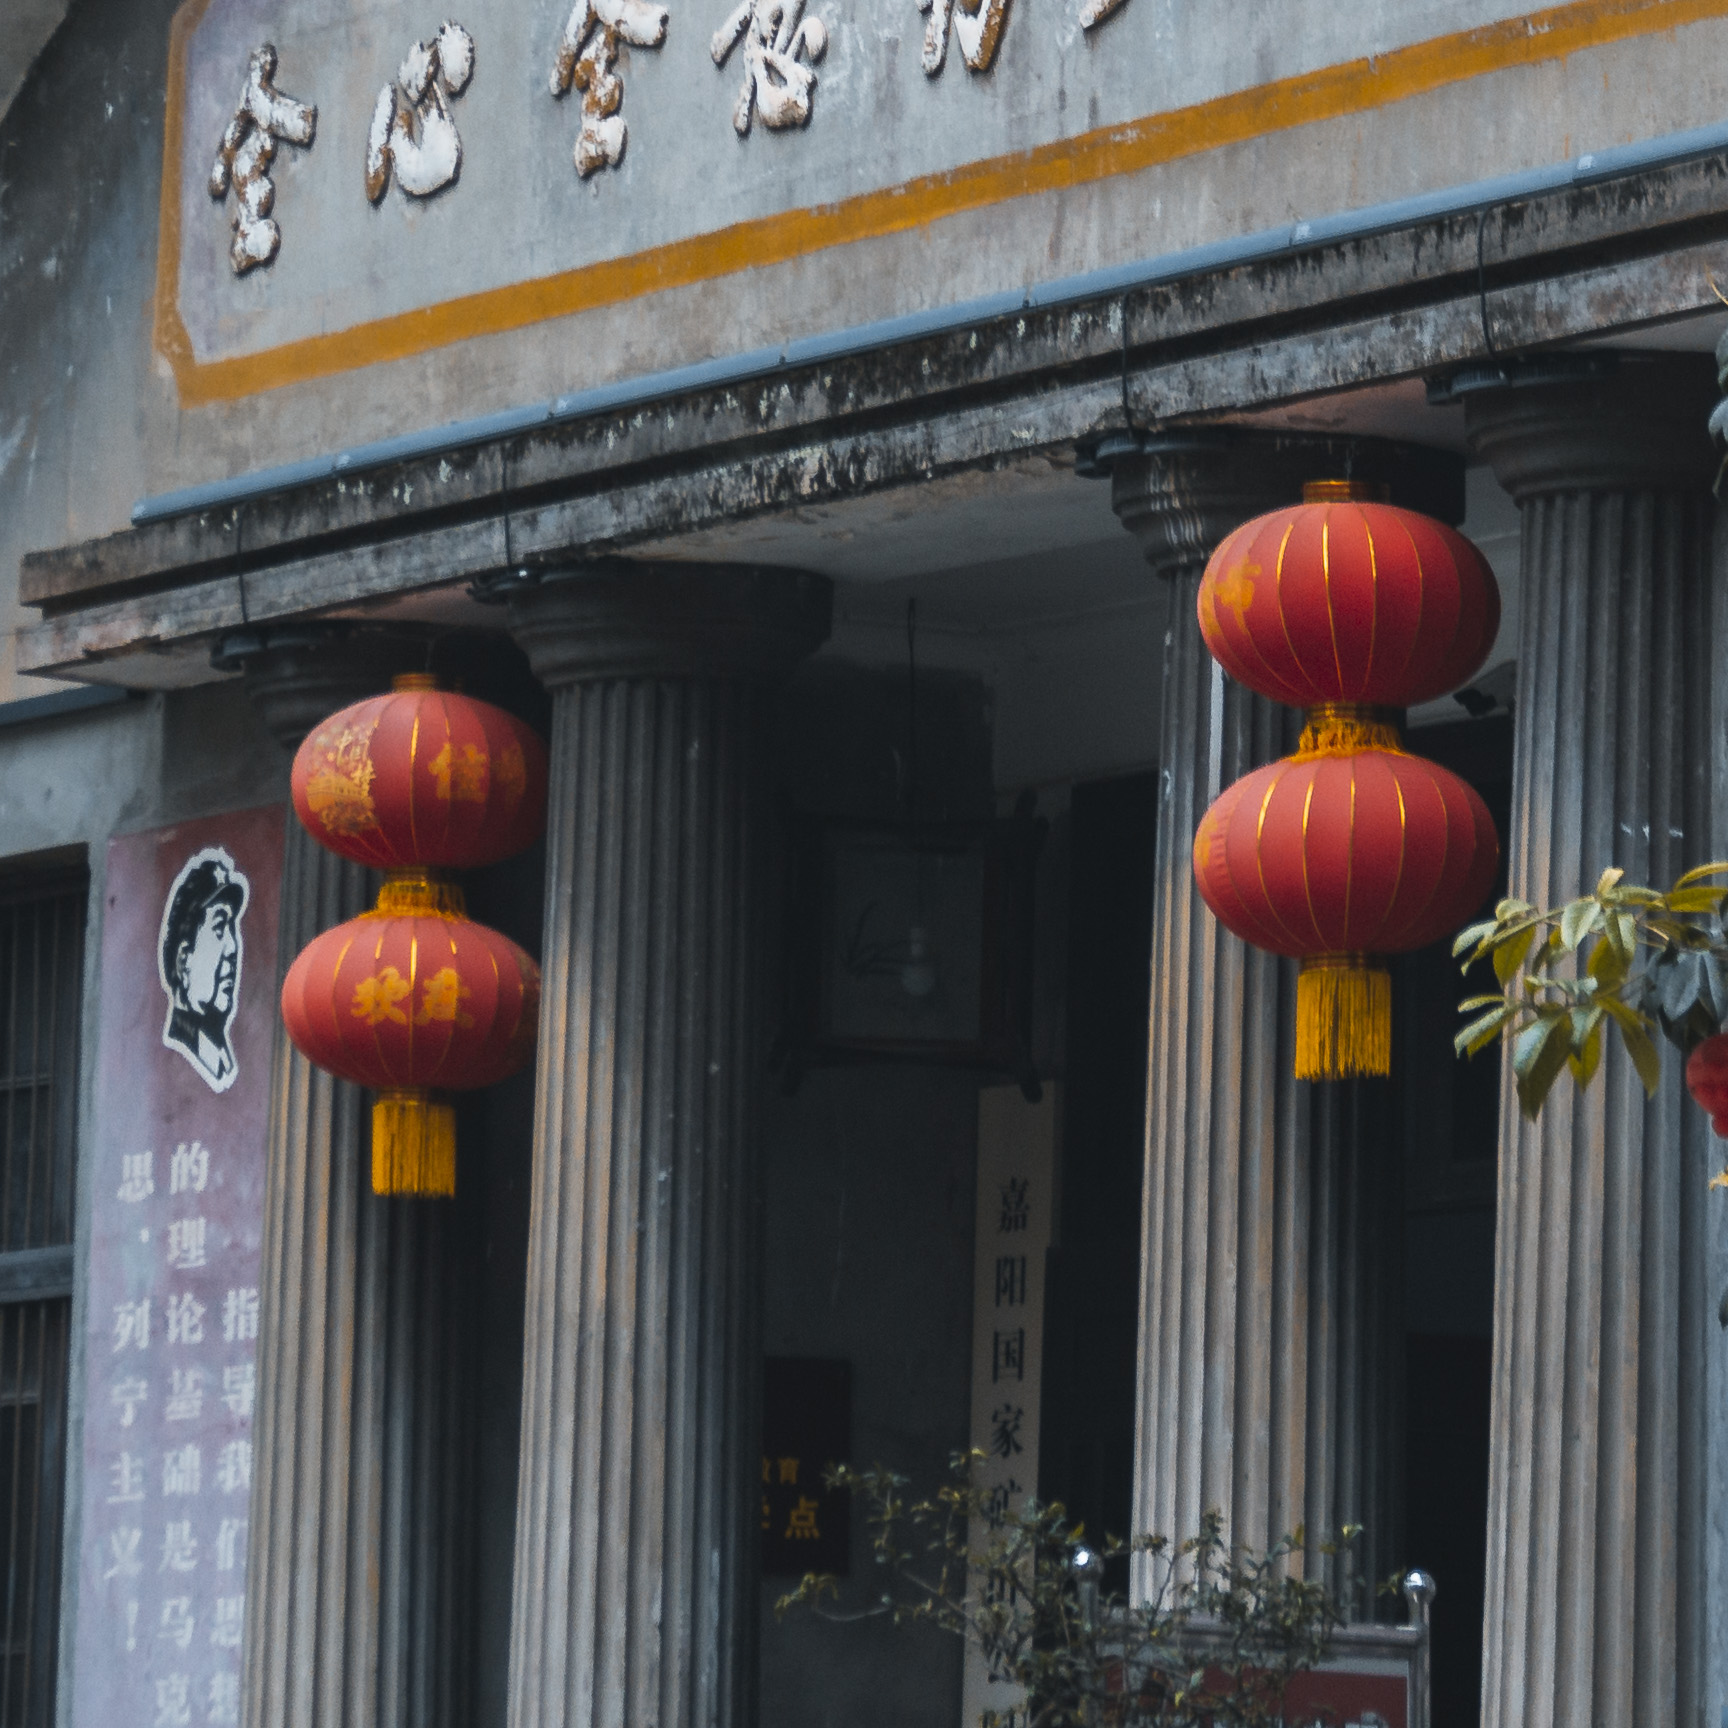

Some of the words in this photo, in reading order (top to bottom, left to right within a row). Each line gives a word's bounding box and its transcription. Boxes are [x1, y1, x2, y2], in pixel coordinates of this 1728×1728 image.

[154, 1140, 210, 1728] 的理论基础是马克
